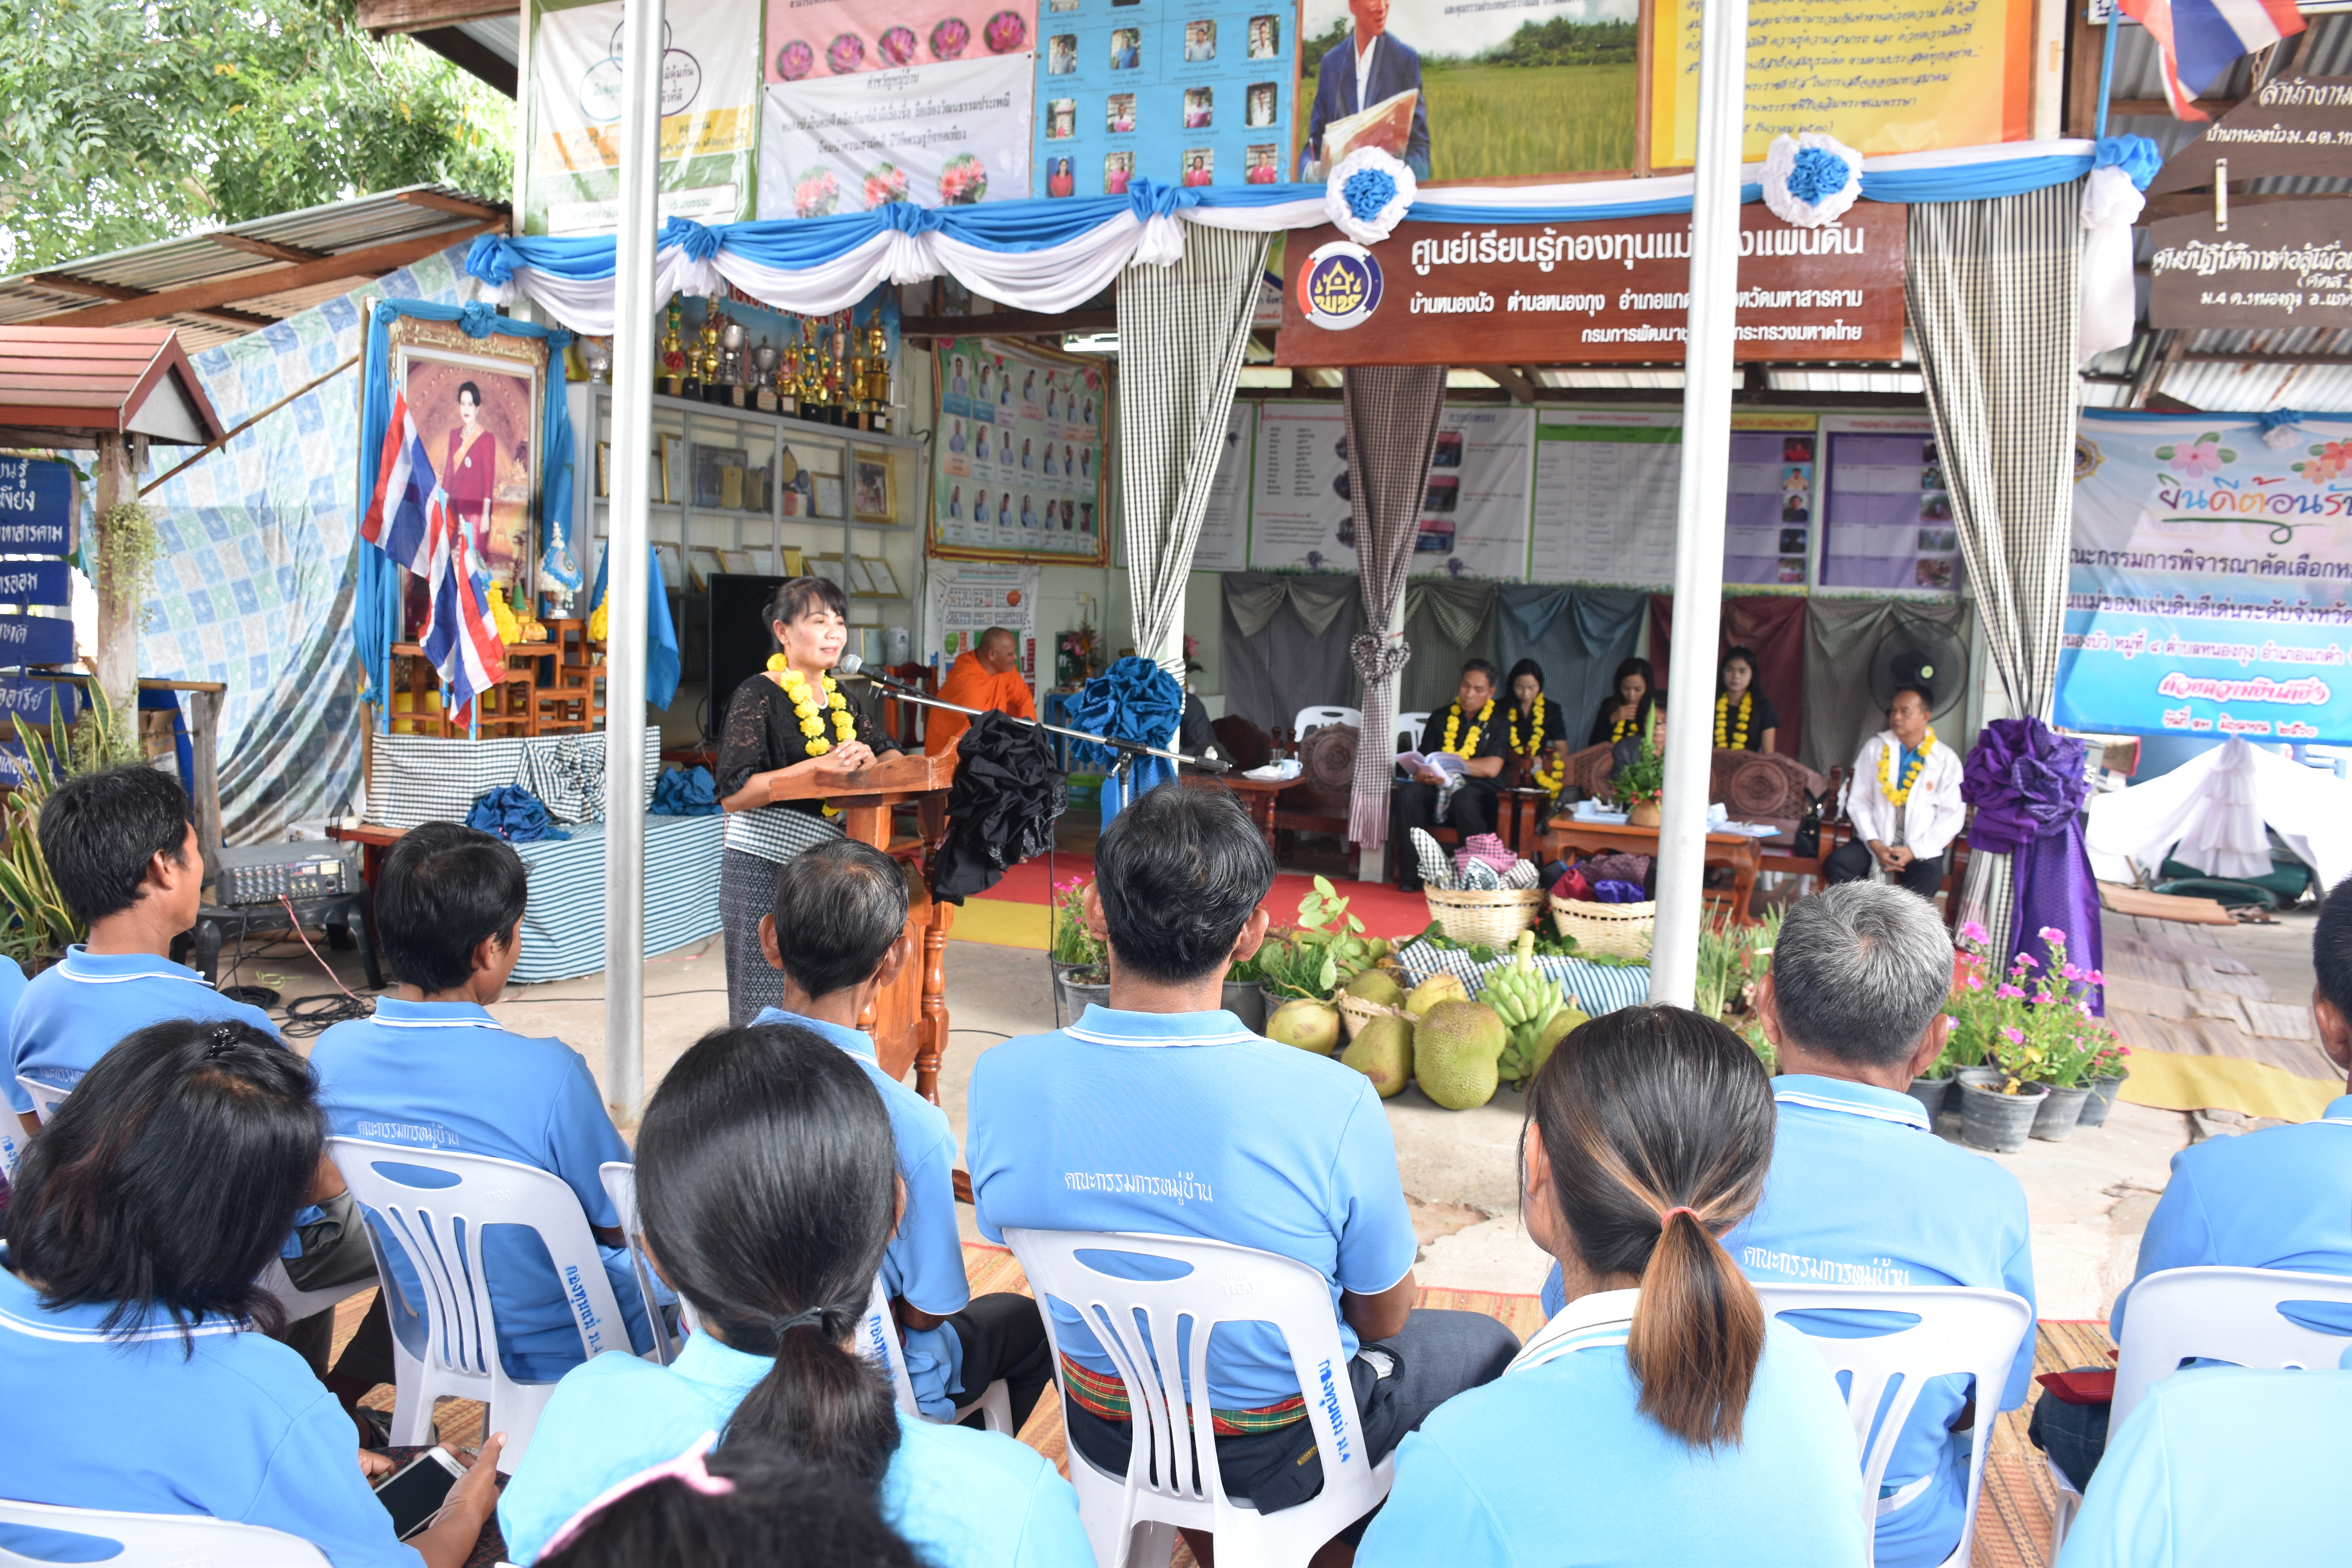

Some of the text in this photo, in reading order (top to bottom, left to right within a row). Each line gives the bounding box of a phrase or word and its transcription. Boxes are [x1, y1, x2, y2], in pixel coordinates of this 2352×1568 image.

[1410, 291, 1495, 314] บ้านหนองบัว
[1507, 290, 1606, 317] ตำบลหนองกุง
[1734, 286, 1863, 308] หวัดมหาสารคาม
[357, 1121, 460, 1149] คณะกรรมการหมู่บ้าน
[1065, 1171, 1213, 1206] คณะกรรมการหมู่บ้าน
[1744, 1246, 1909, 1286] คณะกรรมการหม่บ้าน
